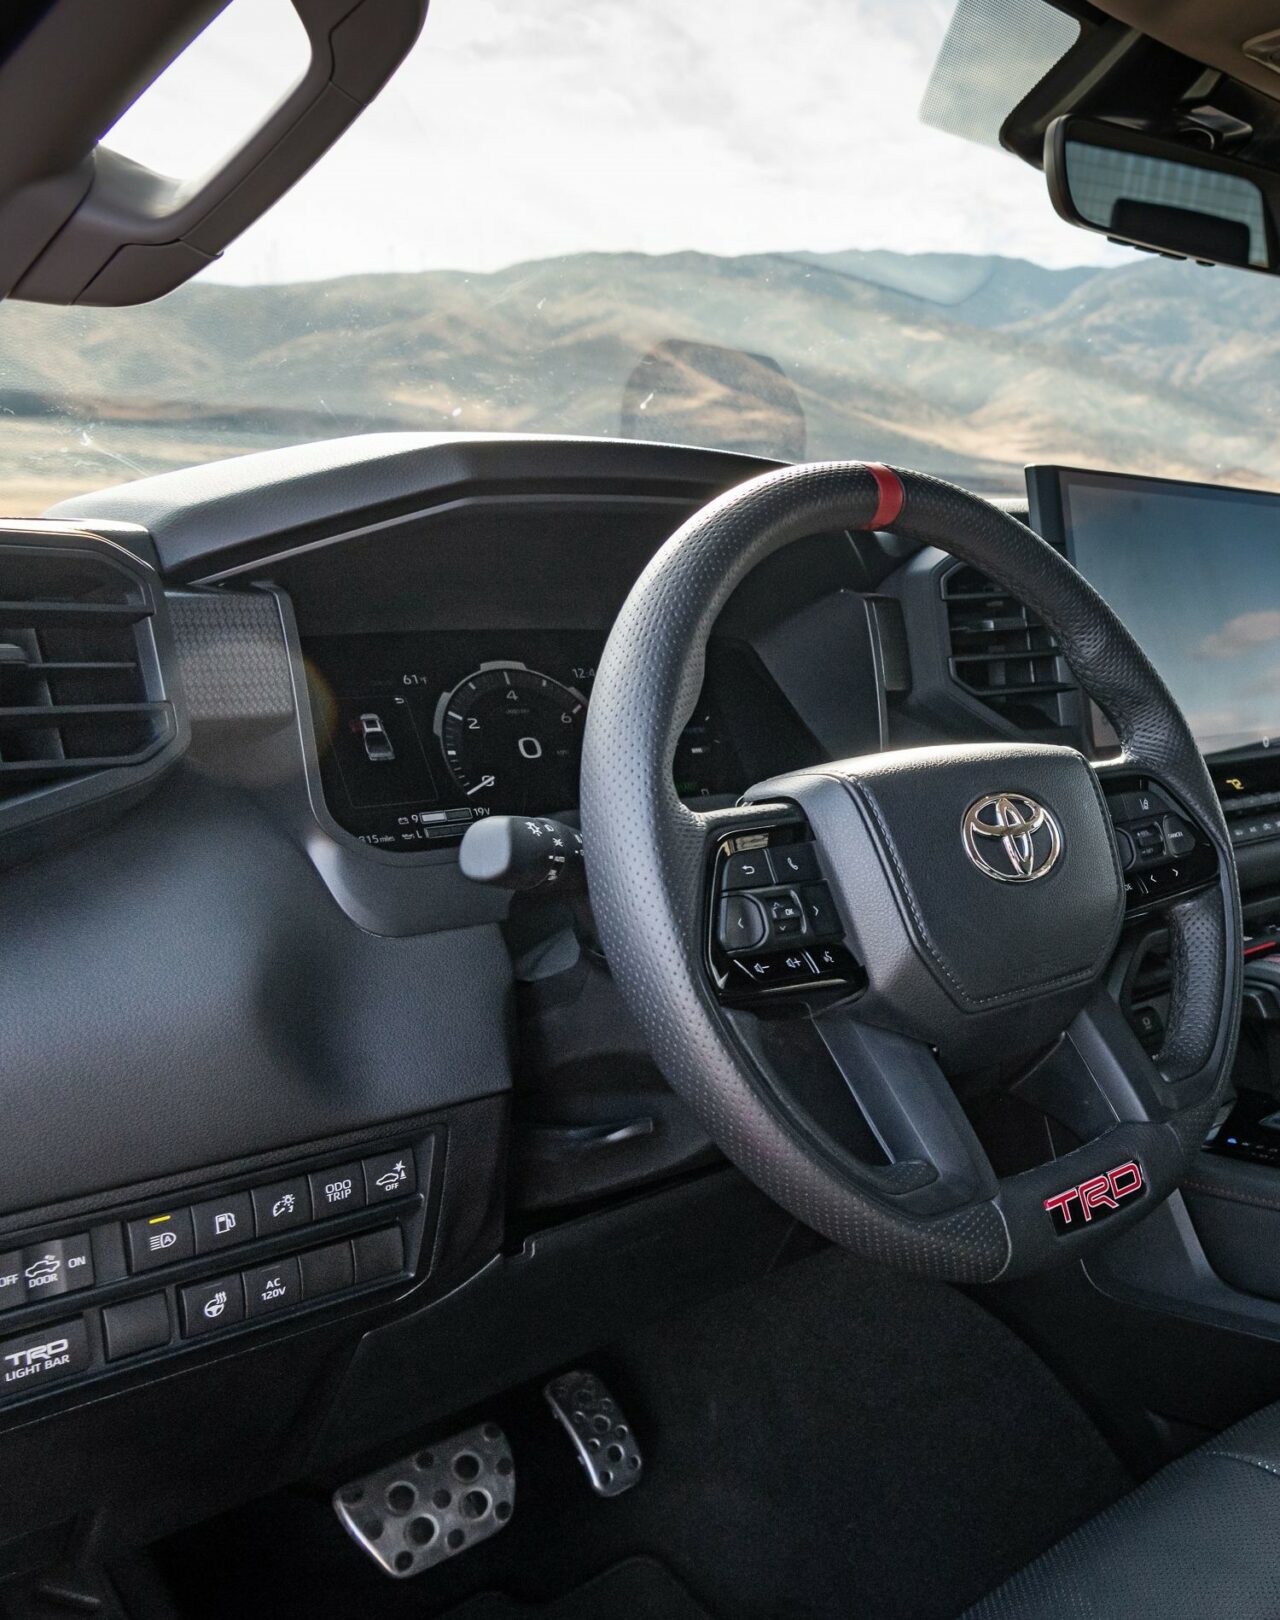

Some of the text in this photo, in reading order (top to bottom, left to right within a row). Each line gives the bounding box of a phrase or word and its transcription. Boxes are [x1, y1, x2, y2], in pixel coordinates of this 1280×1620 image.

[506, 690, 518, 700] 4
[467, 717, 480, 730] 2
[561, 712, 572, 724] 6
[518, 737, 542, 759] 0
[325, 1179, 352, 1195] ODO
[385, 1182, 399, 1192] OFF
[1043, 1160, 1142, 1224] TRD
[326, 1188, 352, 1203] TRIP
[68, 1255, 87, 1268] ON
[0, 1273, 19, 1288] OFF
[28, 1273, 59, 1289] DOOR
[265, 1277, 281, 1290] AC
[261, 1286, 286, 1301] 120V
[4, 1338, 69, 1366] TRD
[5, 1354, 70, 1382] LIGHT BAR
